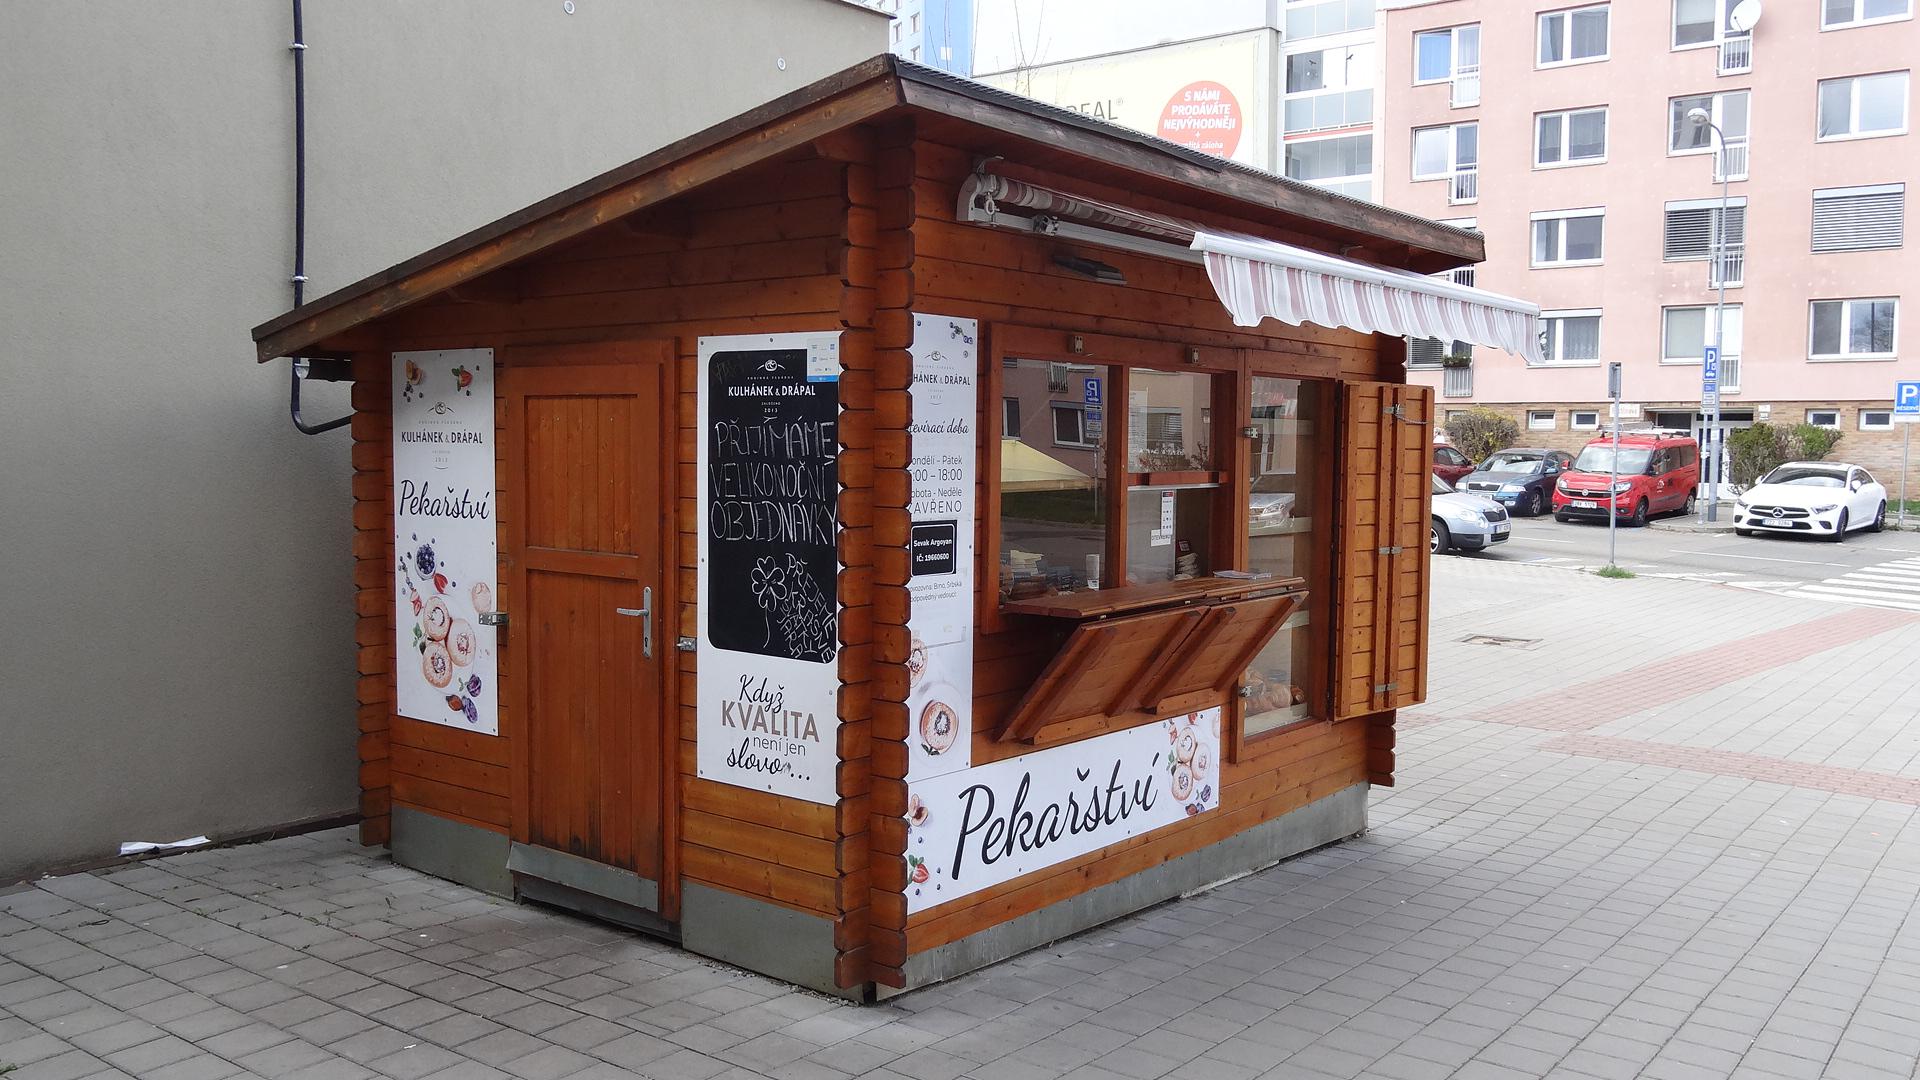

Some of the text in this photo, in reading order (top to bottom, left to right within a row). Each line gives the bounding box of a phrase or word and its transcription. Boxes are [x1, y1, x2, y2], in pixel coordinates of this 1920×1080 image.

[1184, 88, 1220, 102] S NÁMI
[1172, 102, 1231, 116] PRODÁVÁTE
[1164, 116, 1236, 130] NEJVÝHODNĚJI
[1707, 350, 1716, 370] P
[914, 370, 938, 384] HÁNEK
[944, 374, 970, 386] DRÁPAL
[728, 383, 773, 396] KULHÁNEK
[782, 382, 816, 396] DRÁPAL
[1902, 384, 1918, 404] P
[909, 418, 969, 434] tevírací doba
[401, 428, 443, 443] KULHÁNEK
[451, 428, 482, 444] DRÁPAL
[912, 455, 934, 465] ondělí
[942, 455, 962, 464] Pátek
[910, 469, 928, 481] :00
[938, 468, 962, 481] 18:00
[399, 479, 490, 520] Pekařství
[912, 488, 931, 498] obota
[938, 486, 962, 497] Neděle
[914, 539, 930, 547] Sevak
[740, 674, 784, 714] Když
[722, 700, 820, 742] KVALITA
[754, 736, 806, 756] není jen
[952, 752, 1160, 880] Pekařství
